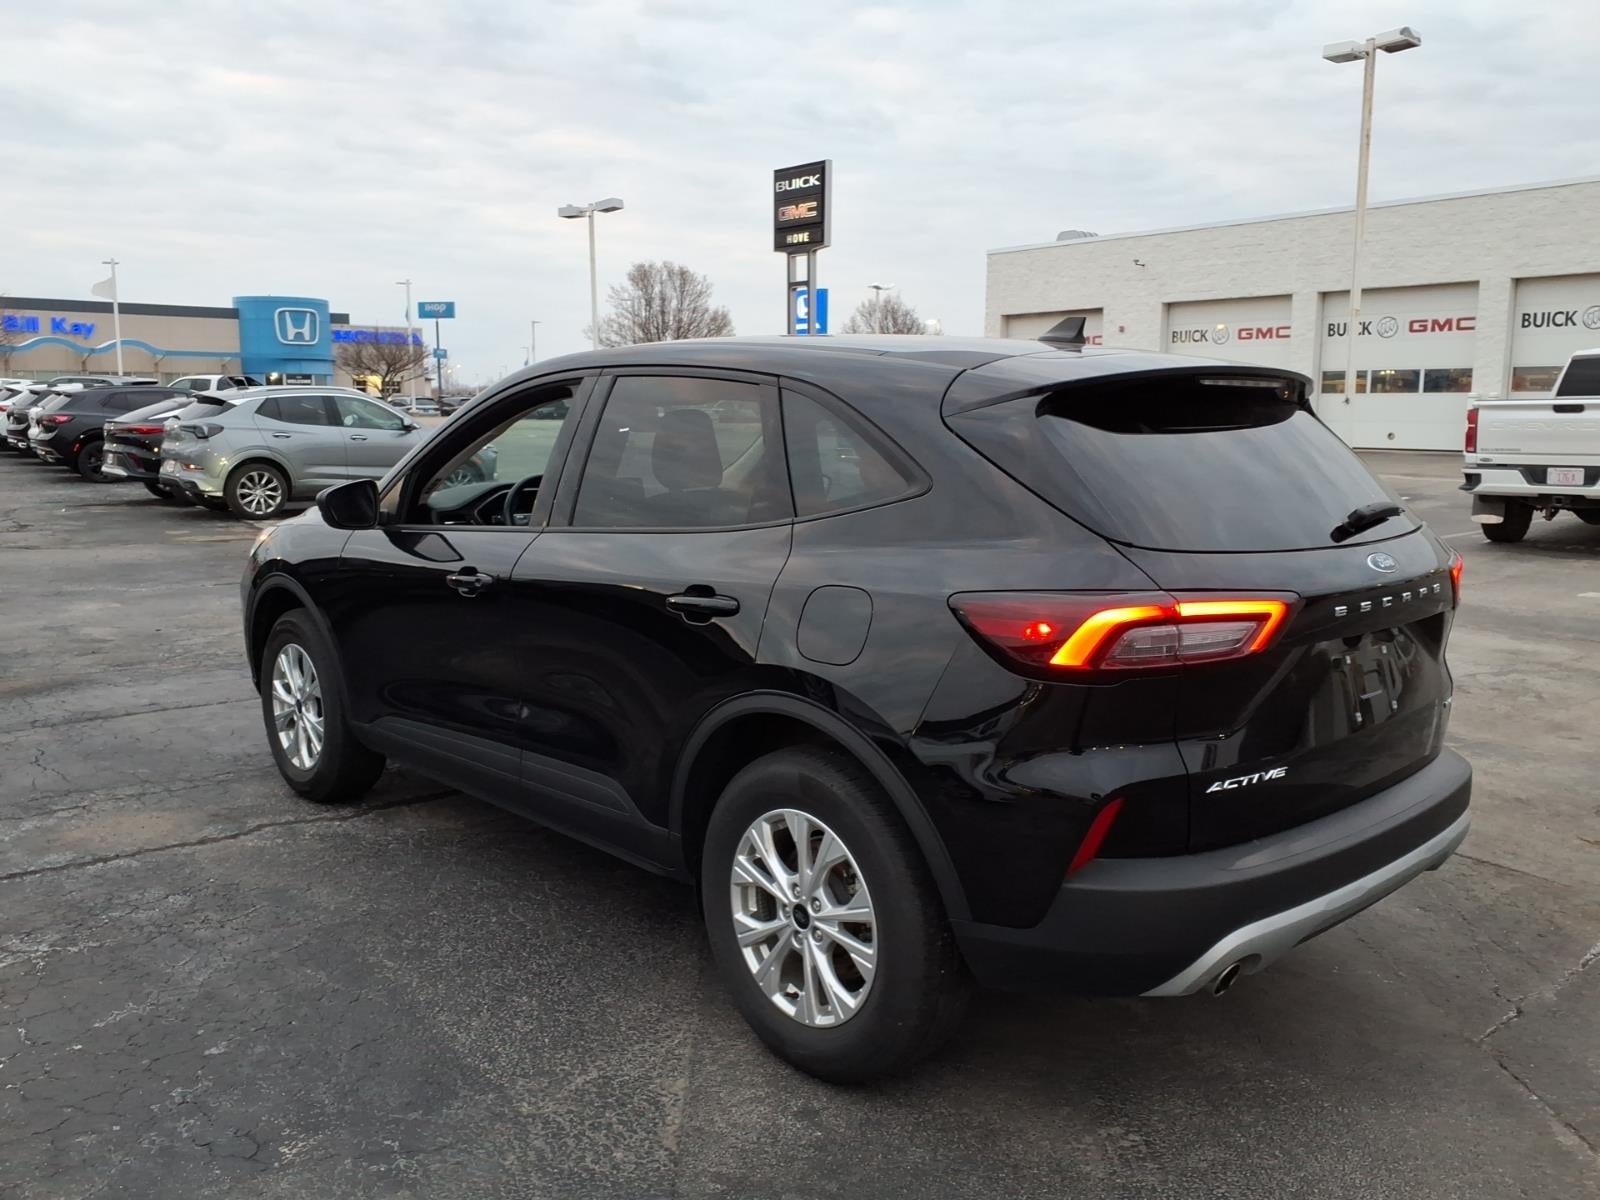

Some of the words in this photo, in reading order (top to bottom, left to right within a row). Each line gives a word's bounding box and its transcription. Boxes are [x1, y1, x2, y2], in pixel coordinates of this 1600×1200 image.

[776, 174, 821, 193] BUICK
[778, 202, 817, 222] GMC
[50, 317, 96, 340] Kay
[1327, 321, 1372, 337] BUK
[1408, 316, 1476, 333] GMC
[1521, 310, 1578, 328] BUICK
[1171, 329, 1208, 344] BUICK
[1237, 326, 1292, 341] GMC
[1334, 583, 1441, 617] ESCAPE
[1204, 766, 1289, 794] ACTIVE
